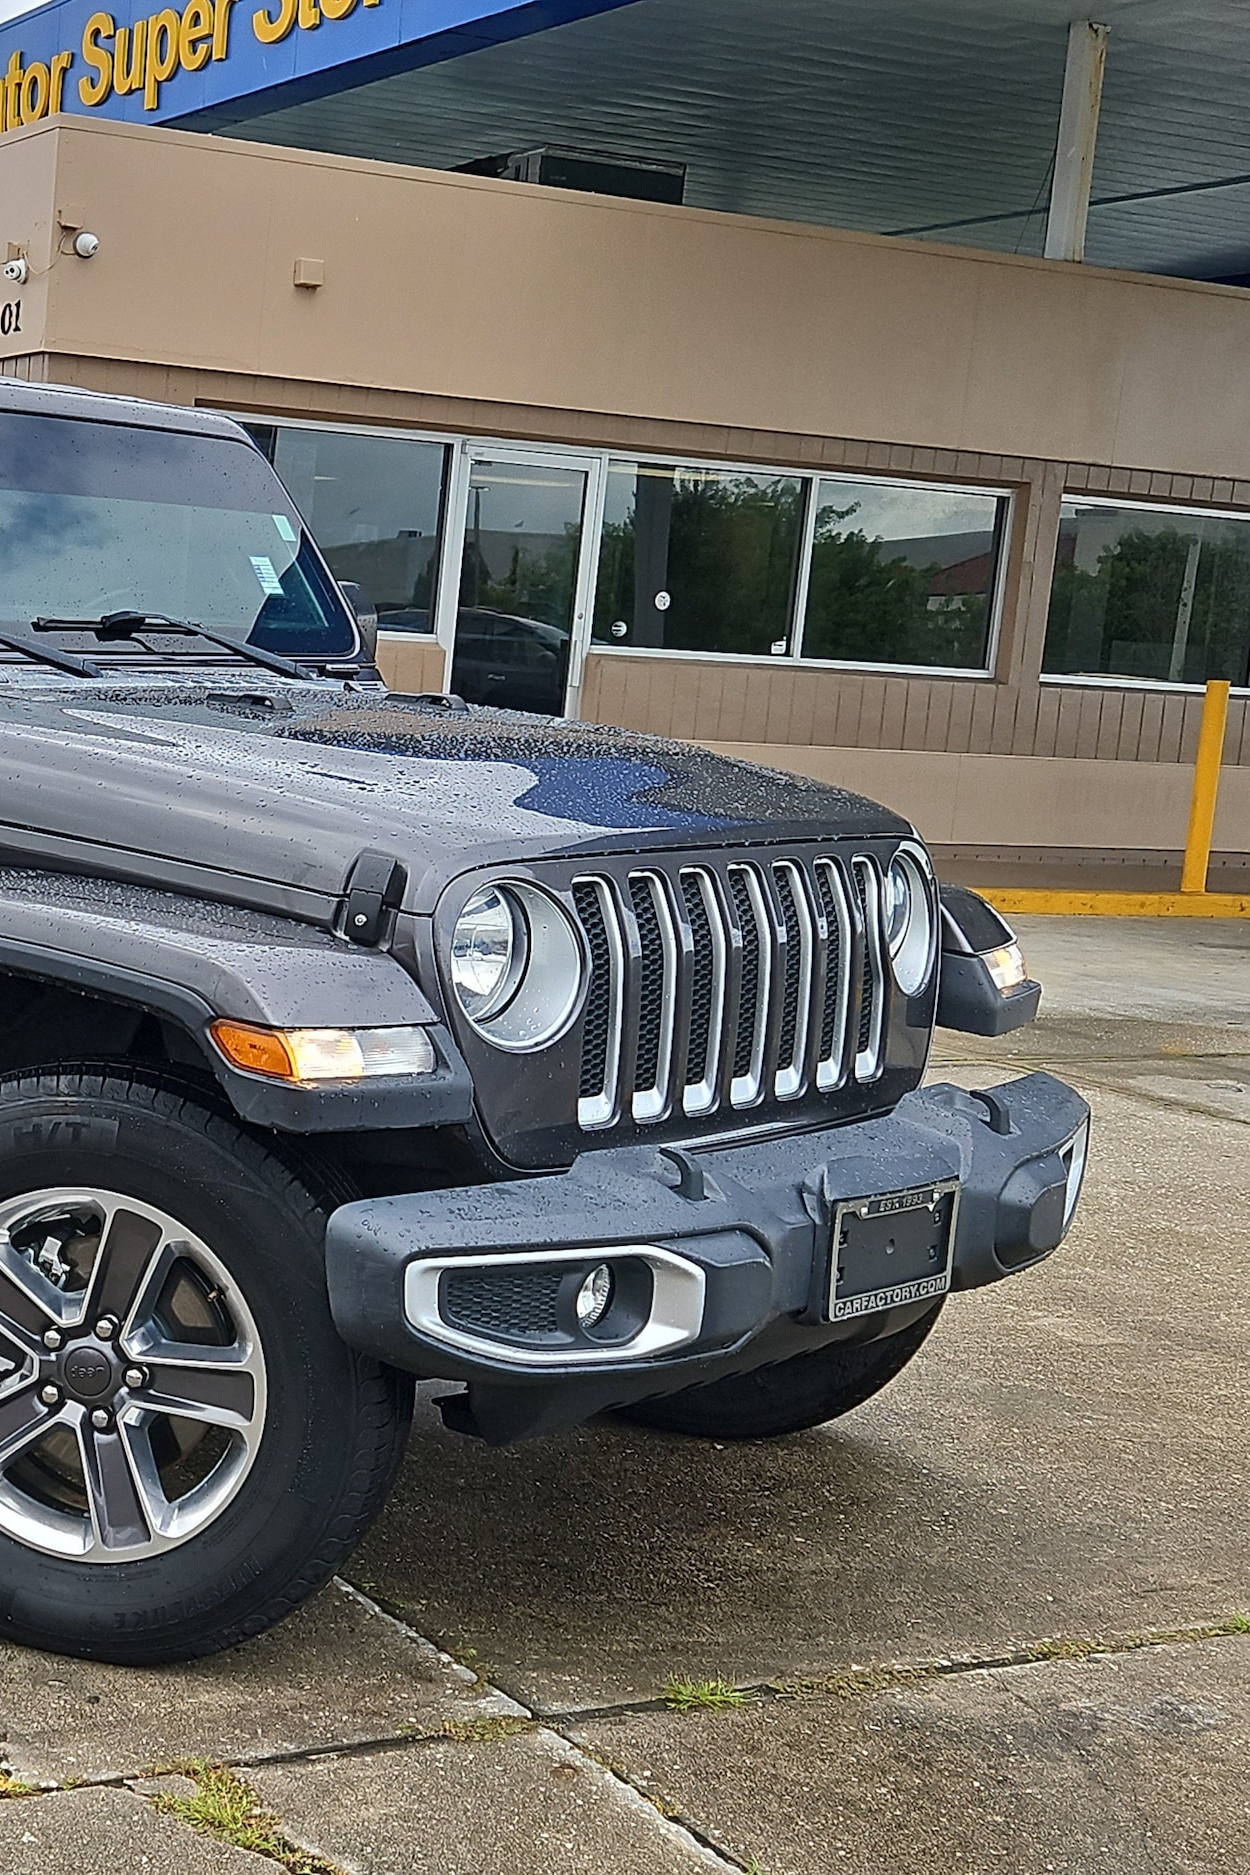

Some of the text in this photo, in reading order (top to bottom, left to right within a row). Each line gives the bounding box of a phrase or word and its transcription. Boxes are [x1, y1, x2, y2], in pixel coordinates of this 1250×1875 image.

[78, 0, 232, 111] Super
[13, 1120, 91, 1146] H/T
[835, 1277, 946, 1317] CARFACTORY.COM
